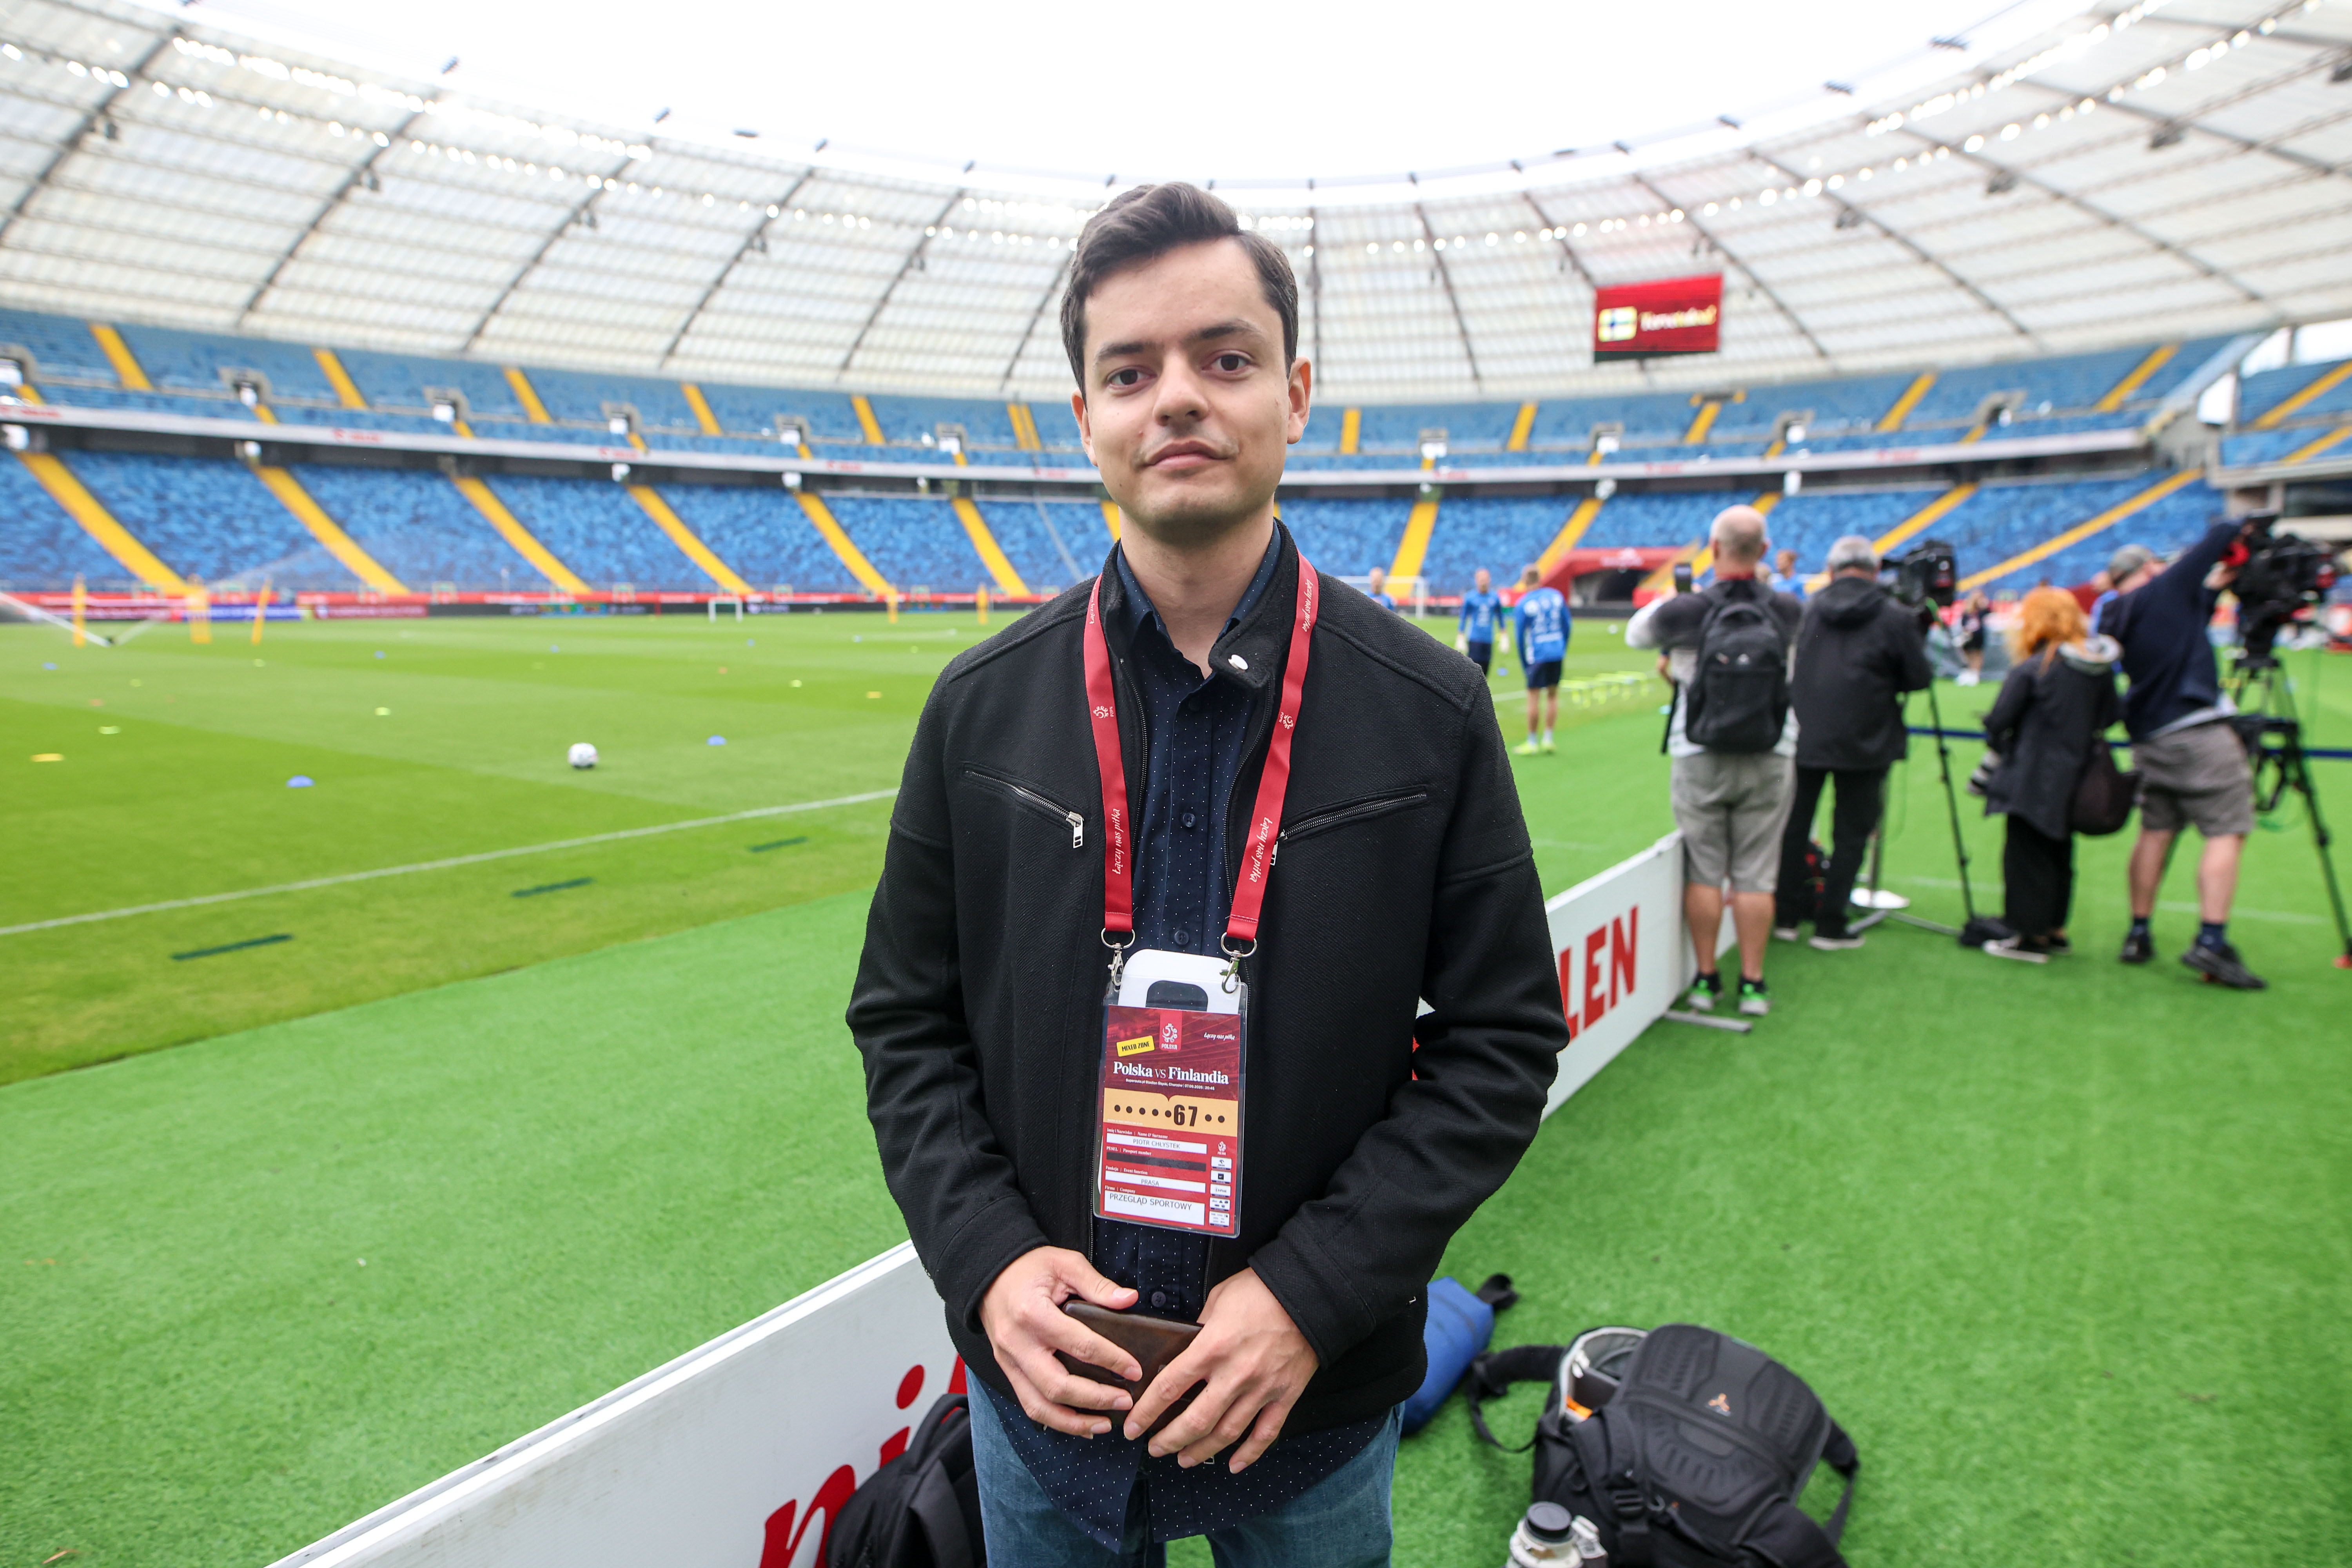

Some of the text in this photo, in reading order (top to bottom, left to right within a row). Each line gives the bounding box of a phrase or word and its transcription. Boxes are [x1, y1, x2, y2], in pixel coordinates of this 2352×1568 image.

[1111, 808, 1124, 833] piłka
[1249, 817, 1273, 882] Łączy nas piłka
[1112, 848, 1125, 875] Łączy
[1559, 904, 1640, 1041] LEN
[1122, 1043, 1136, 1051] MIXED
[1204, 1032, 1216, 1040] Łączy
[1113, 1061, 1153, 1078] Polska
[1168, 1066, 1229, 1085] Finlandia
[1174, 1104, 1198, 1127] 67
[1152, 1141, 1180, 1149] CHŁYSTEK
[1110, 1193, 1192, 1210] PRZEGLĄD SPORTOWY
